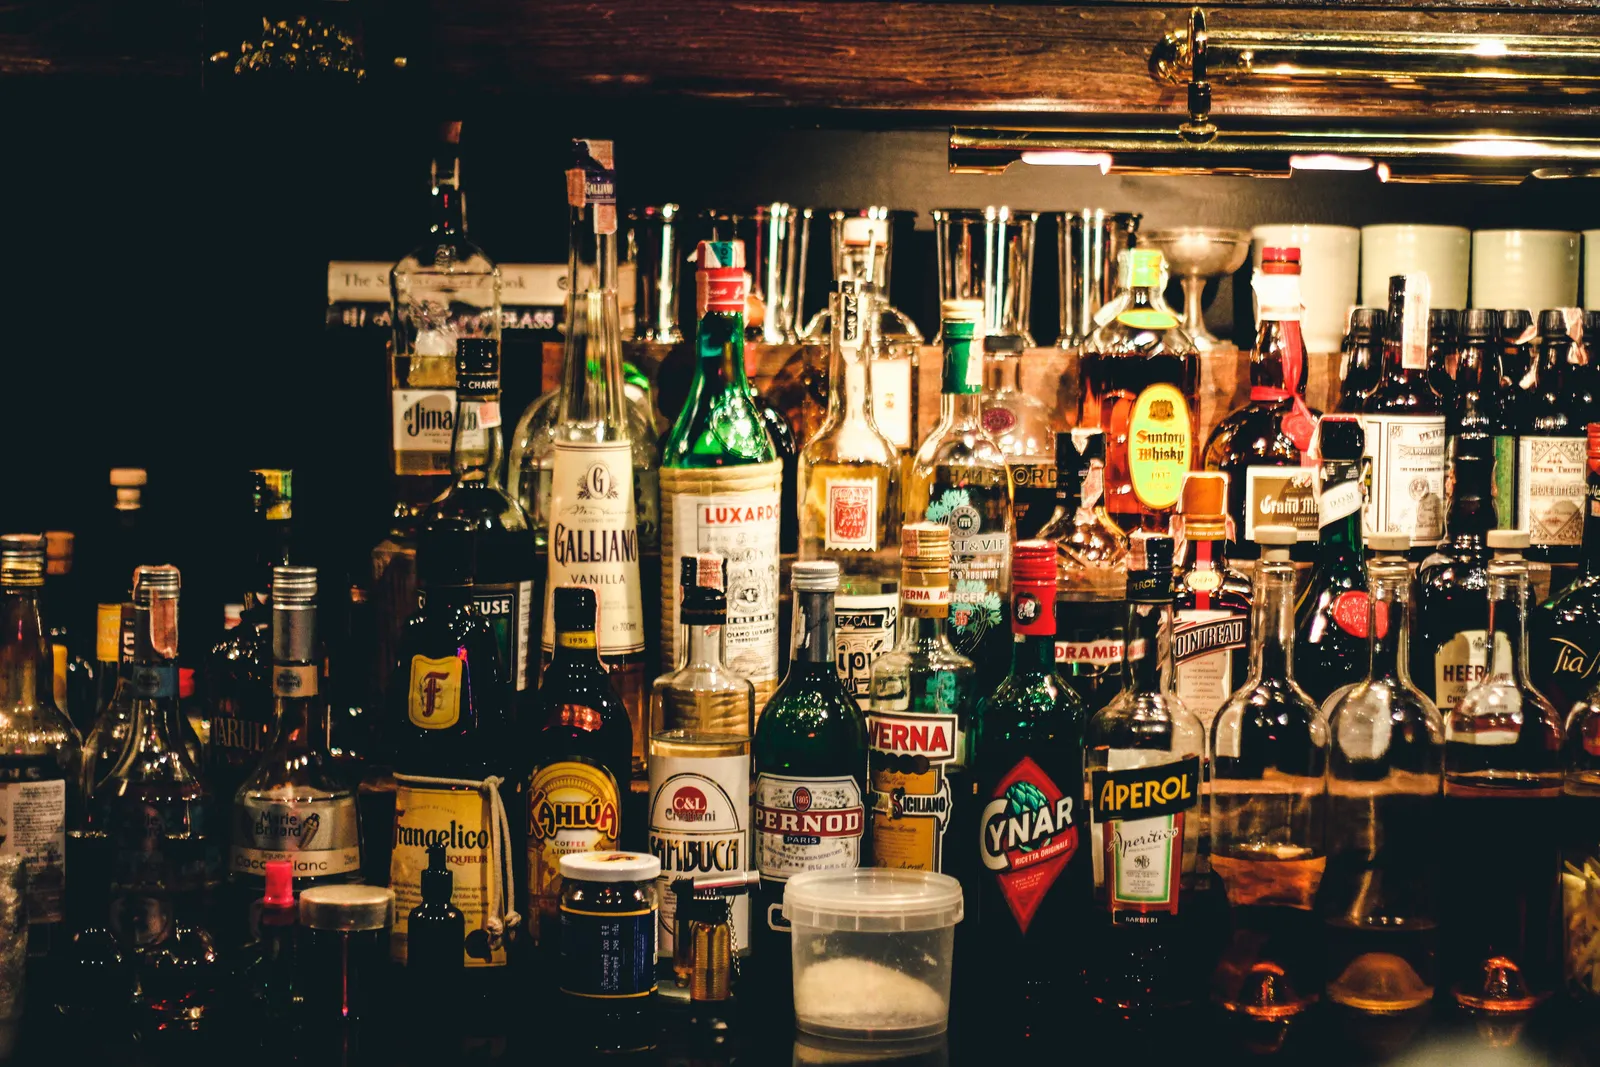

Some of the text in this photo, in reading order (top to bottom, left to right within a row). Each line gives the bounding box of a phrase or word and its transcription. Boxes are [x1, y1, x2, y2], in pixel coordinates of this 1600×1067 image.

[1136, 429, 1185, 448] Suntory
[1136, 447, 1184, 464] Whisky
[1260, 495, 1299, 514] Grand
[554, 523, 637, 567] GALLIANO
[571, 575, 626, 585] VANILLA
[902, 590, 930, 600] VERNA
[948, 592, 985, 602] ERGER
[837, 615, 876, 627] EZCAL
[1174, 622, 1243, 657] OINTREAU
[1549, 637, 1588, 674] Tia
[422, 672, 450, 717] F
[796, 795, 809, 805] 1805
[1100, 773, 1191, 811] APEROL
[674, 797, 705, 810] C&L
[527, 789, 618, 838] KAHLÚA
[755, 808, 860, 833] PERNOD
[787, 836, 817, 844] PARIS
[980, 796, 1074, 870] CYNAR
[1107, 827, 1179, 858] Aperitivo
[446, 855, 488, 866] IQUEUR
[1015, 839, 1068, 866] RICETTA ORIGINALE
[293, 859, 328, 871] lanc
[1125, 916, 1158, 924] BARBIERI
